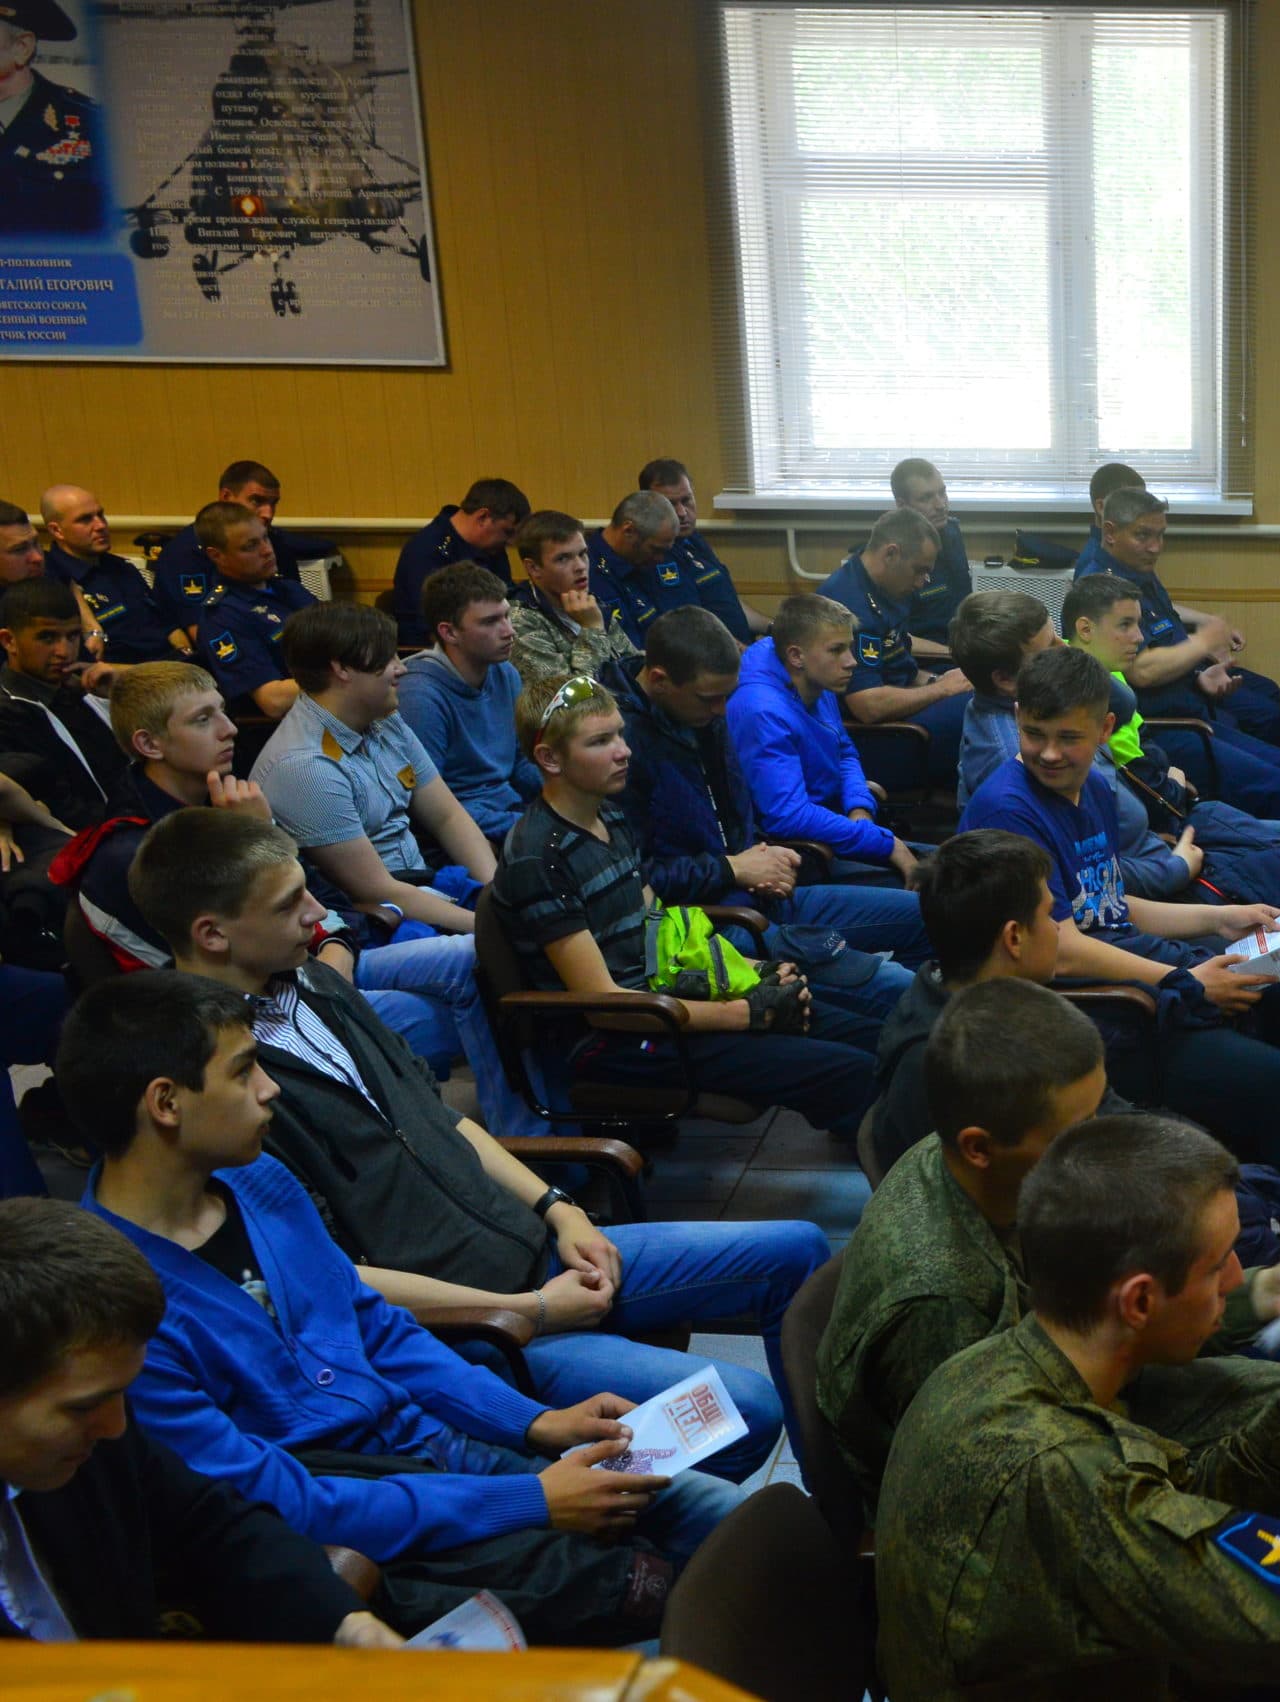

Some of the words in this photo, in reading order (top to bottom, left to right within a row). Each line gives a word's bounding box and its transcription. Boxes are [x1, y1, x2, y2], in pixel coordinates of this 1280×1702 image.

[197, 228, 240, 238] Виталий
[47, 279, 114, 291] ЕГОРОВИЧ
[0, 301, 50, 310] ВЕТСКОГО
[51, 302, 87, 311] СОЮЗА
[39, 315, 87, 325] ВОЕННЫЙ
[28, 332, 66, 340] РОССИИ
